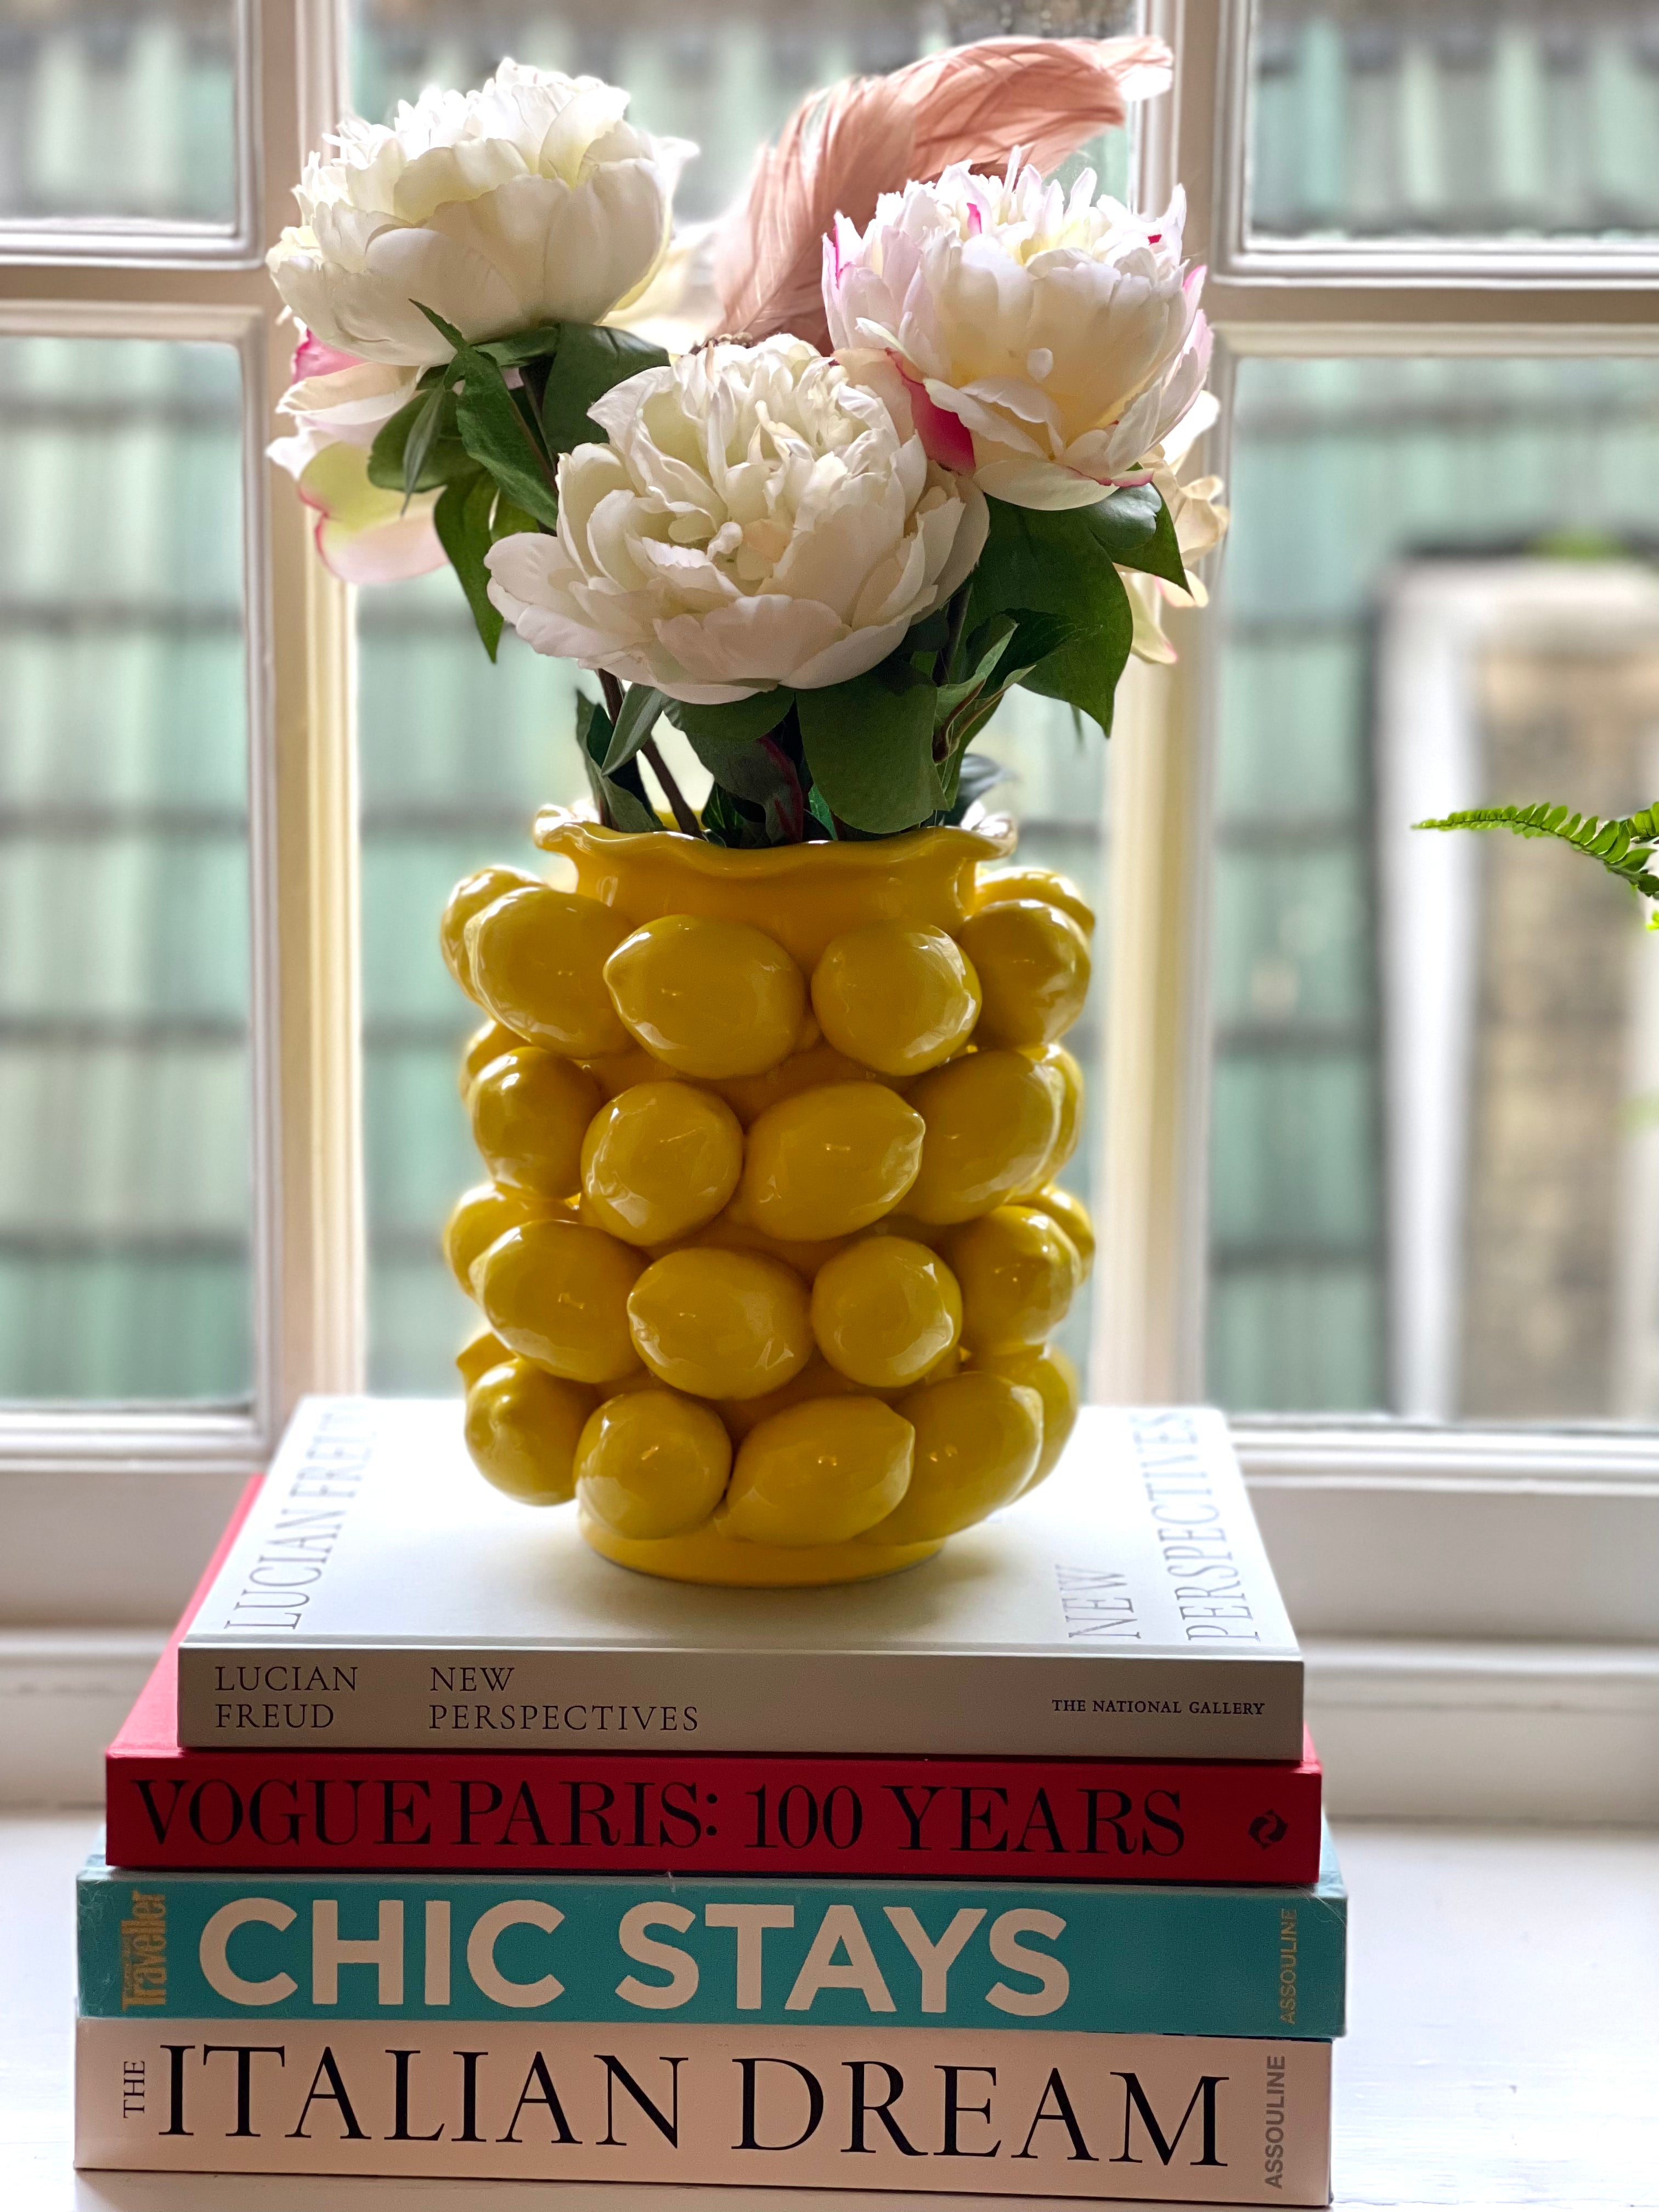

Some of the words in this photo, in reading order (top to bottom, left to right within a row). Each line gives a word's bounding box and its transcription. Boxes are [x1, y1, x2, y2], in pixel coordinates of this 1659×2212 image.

[1129, 1412, 1261, 1642] PERSPECTIVES
[223, 1507, 346, 1630] LUCIAN
[1054, 1564, 1142, 1639] NEW
[215, 1666, 358, 1691] LUCIAN
[215, 1703, 335, 1729] FREUD
[429, 1704, 699, 1731] PERSPECTIVES
[430, 1666, 515, 1692] NEW
[1051, 1699, 1087, 1712] THE
[1092, 1699, 1182, 1714] NATIONAL
[1188, 1701, 1266, 1716] GALLERY
[130, 1778, 432, 1847] VOGUE
[450, 1780, 719, 1850] PARIS:
[745, 1784, 863, 1849] 100
[881, 1784, 1186, 1857] YEARS
[120, 1890, 167, 2012] Traveller
[199, 1897, 566, 2008] CHIC
[614, 1900, 1070, 2017] STAYS
[1280, 1908, 1297, 2025] ASSOULINE
[123, 2060, 145, 2119] THE
[158, 2045, 689, 2149] ITALIAN
[731, 2058, 1229, 2167] DREAM
[1265, 2056, 1285, 2190] ASSOULINE
